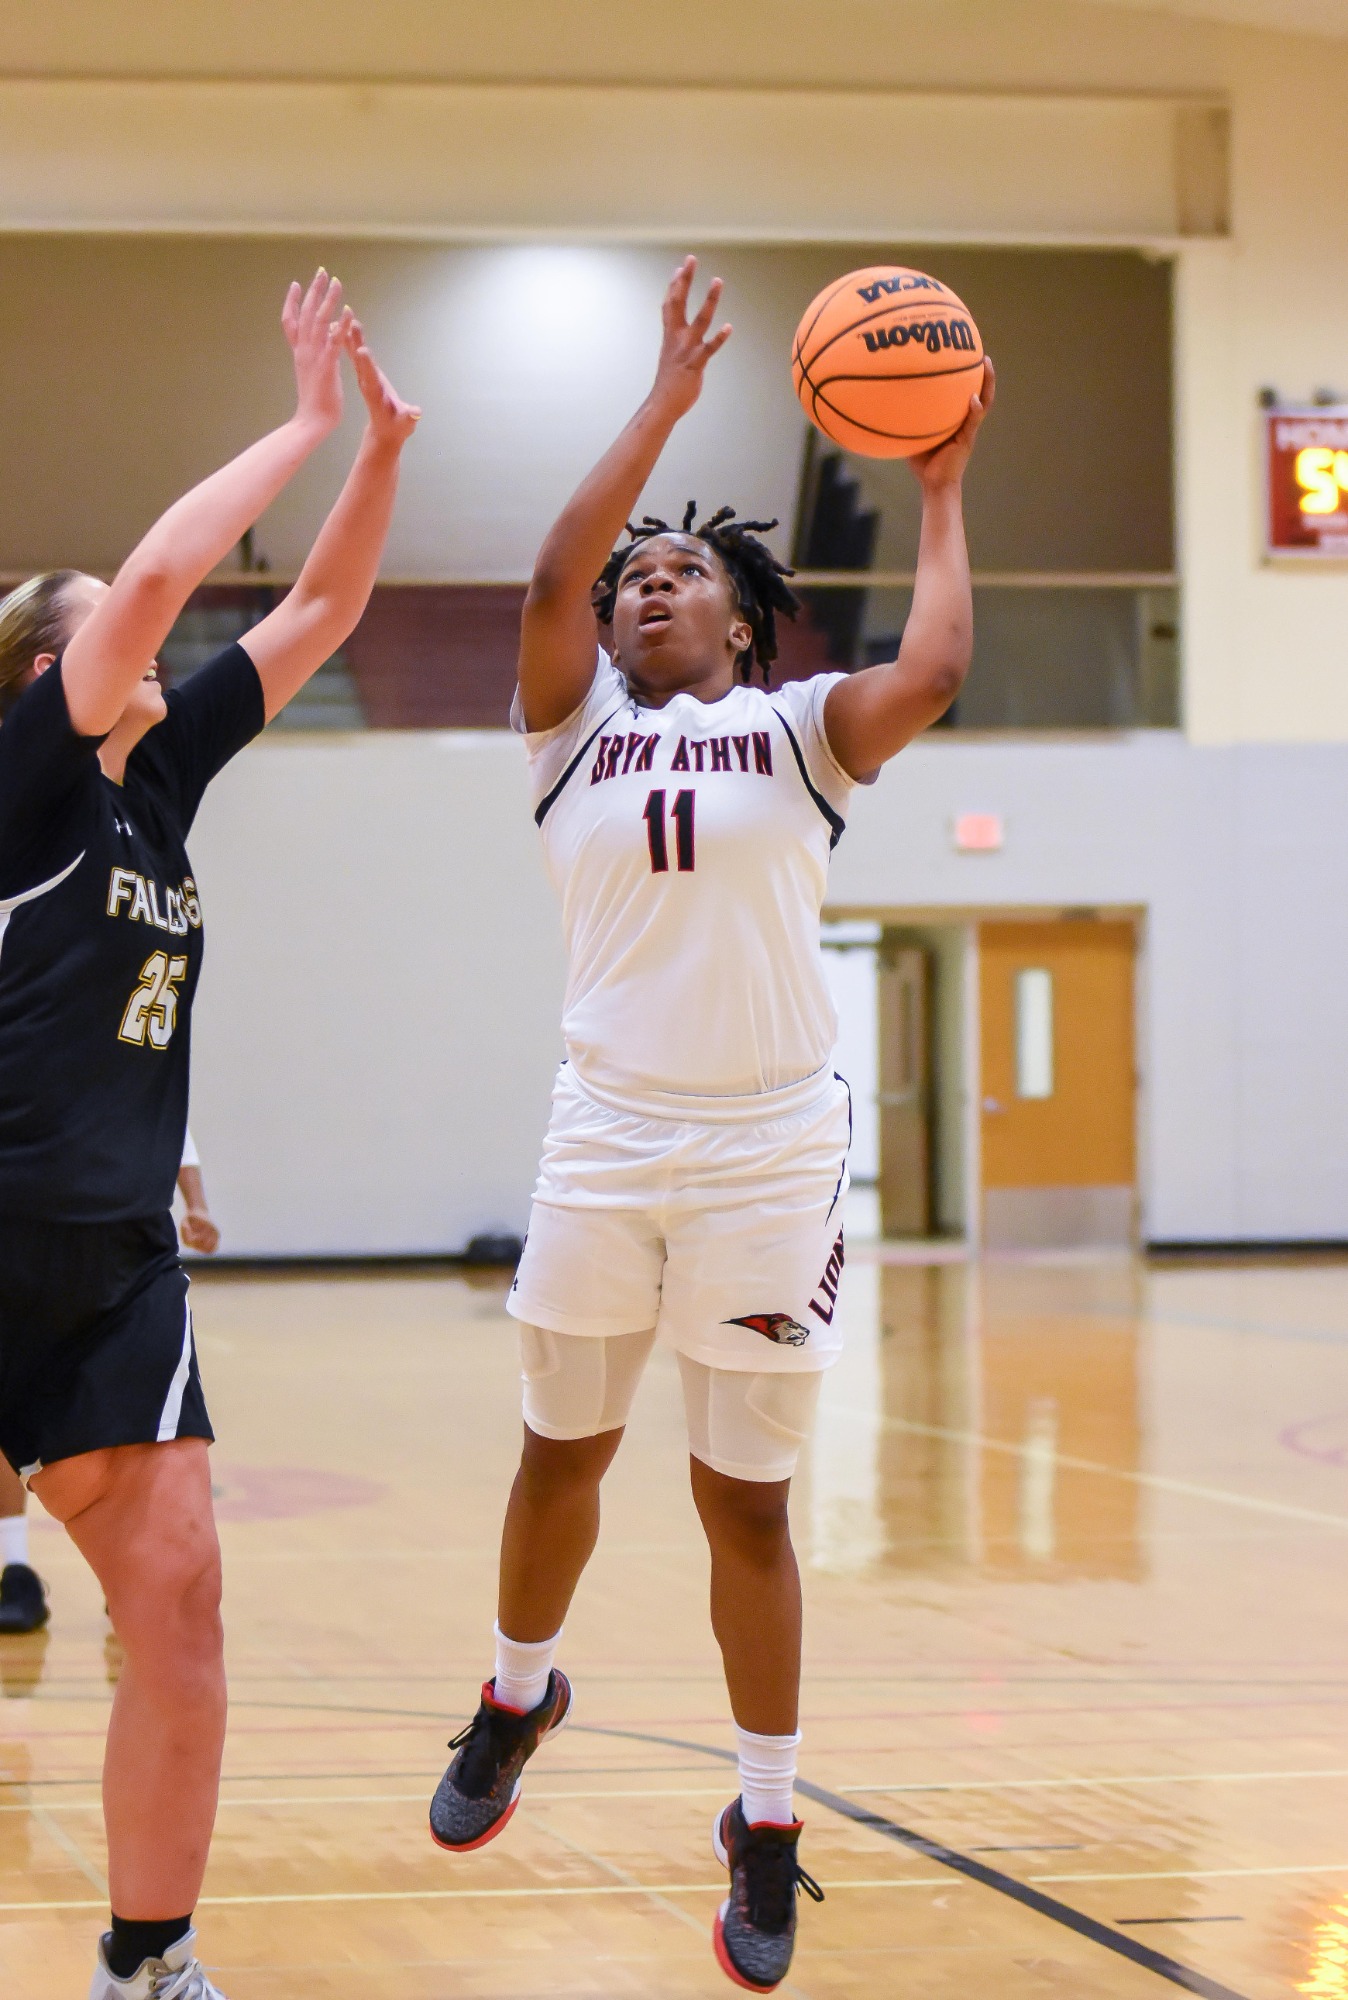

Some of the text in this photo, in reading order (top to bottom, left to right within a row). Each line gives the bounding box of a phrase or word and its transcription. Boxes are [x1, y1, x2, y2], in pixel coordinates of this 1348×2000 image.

[855, 275, 945, 304] NCAA
[863, 318, 977, 353] Wilson
[590, 731, 774, 786] BRYN ATHYN
[642, 788, 696, 873] 11
[106, 866, 204, 936] FALCS
[117, 950, 188, 1050] 25
[807, 1222, 845, 1326] LION
